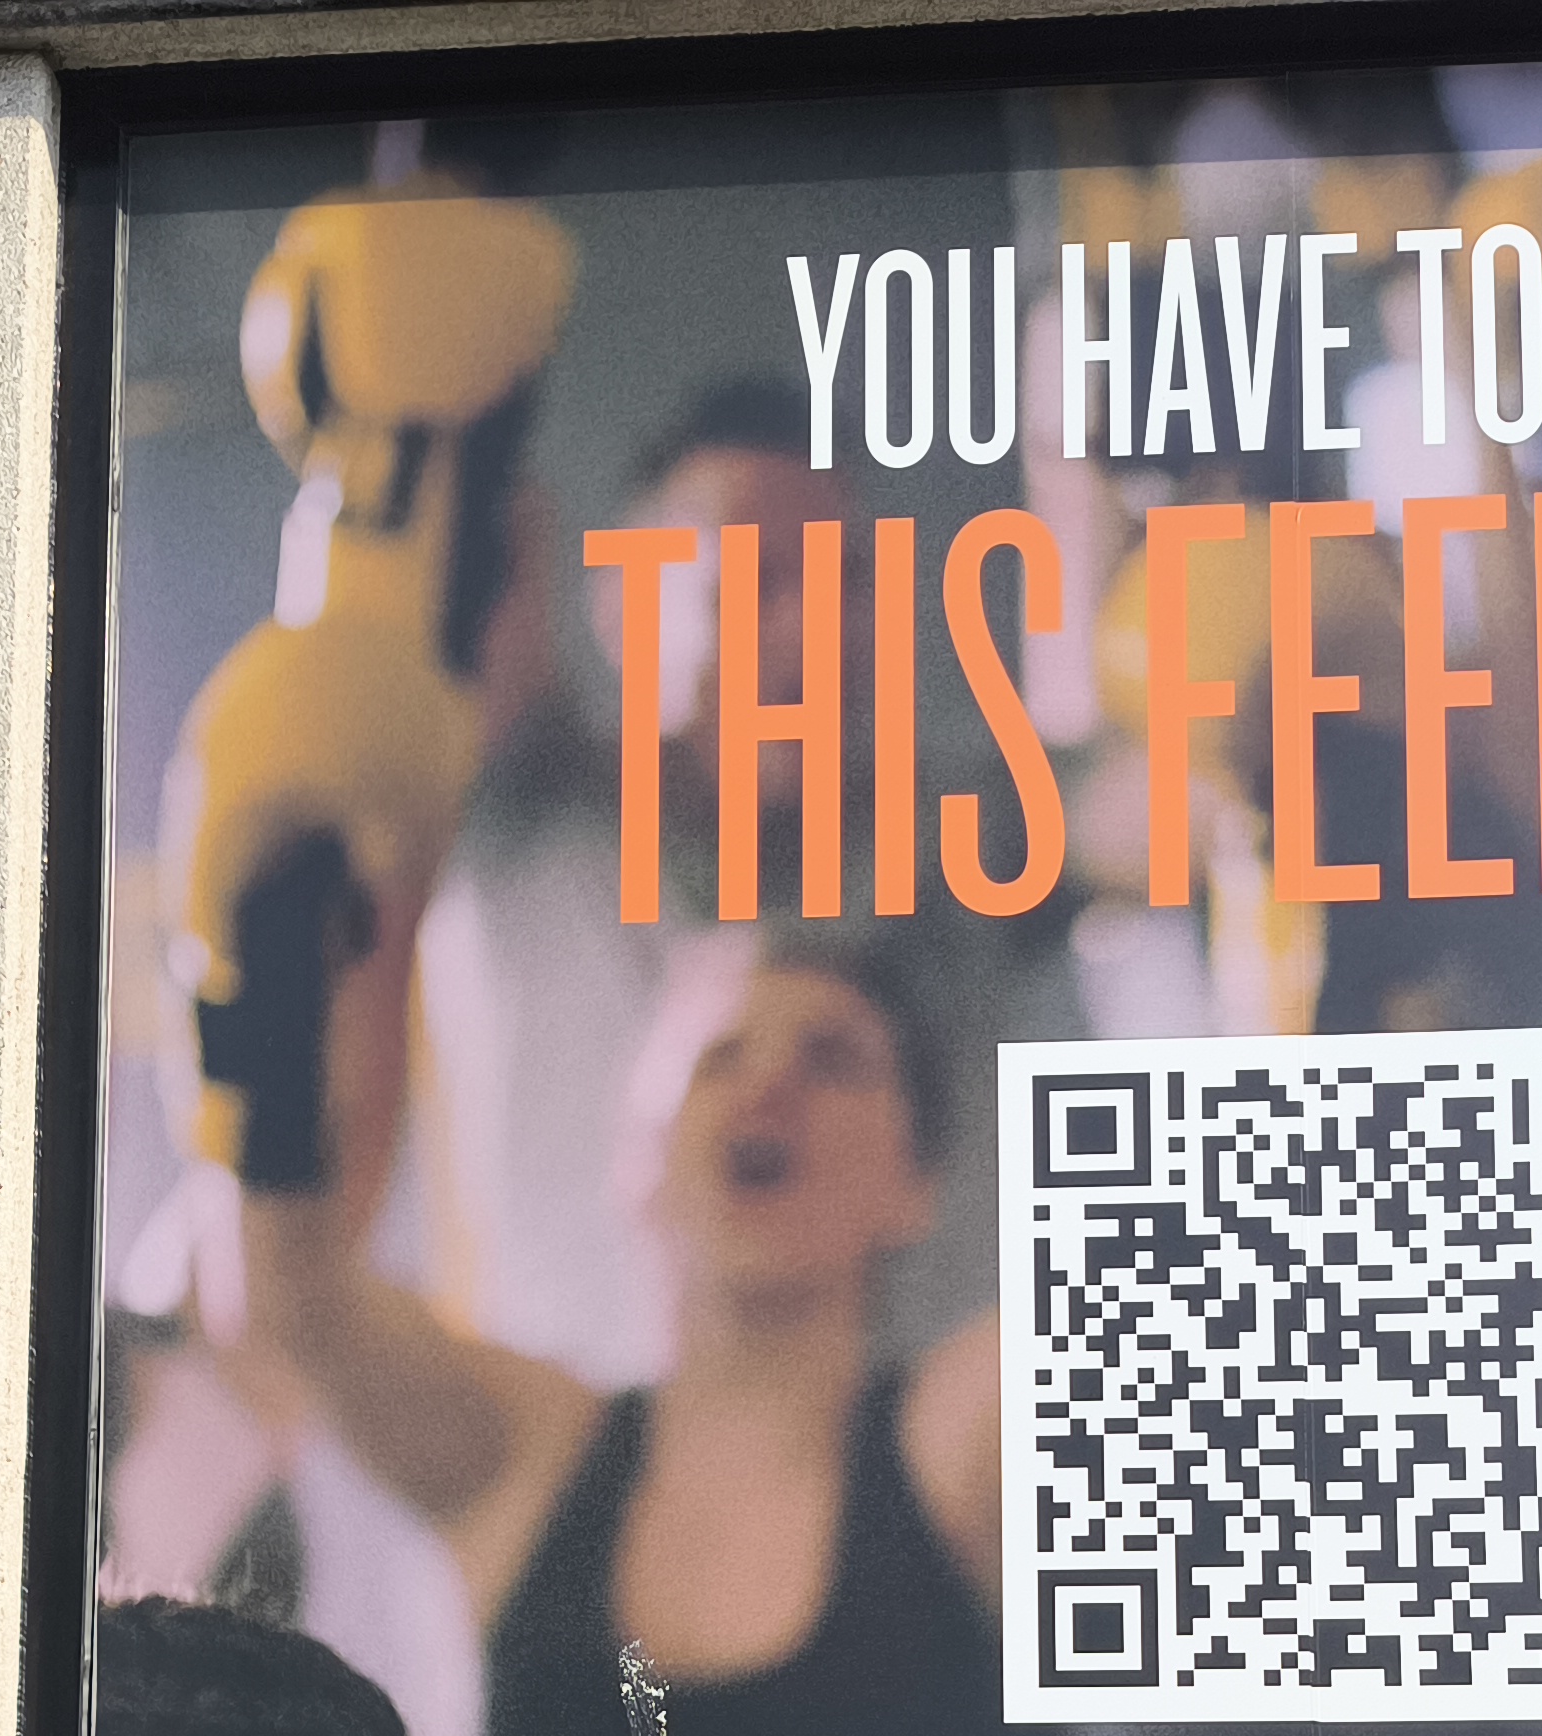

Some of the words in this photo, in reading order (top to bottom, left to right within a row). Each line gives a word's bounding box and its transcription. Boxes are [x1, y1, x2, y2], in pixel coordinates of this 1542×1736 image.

[785, 245, 1017, 471] YOU
[1060, 232, 1362, 460] HAVE
[583, 508, 1067, 925] THIS
